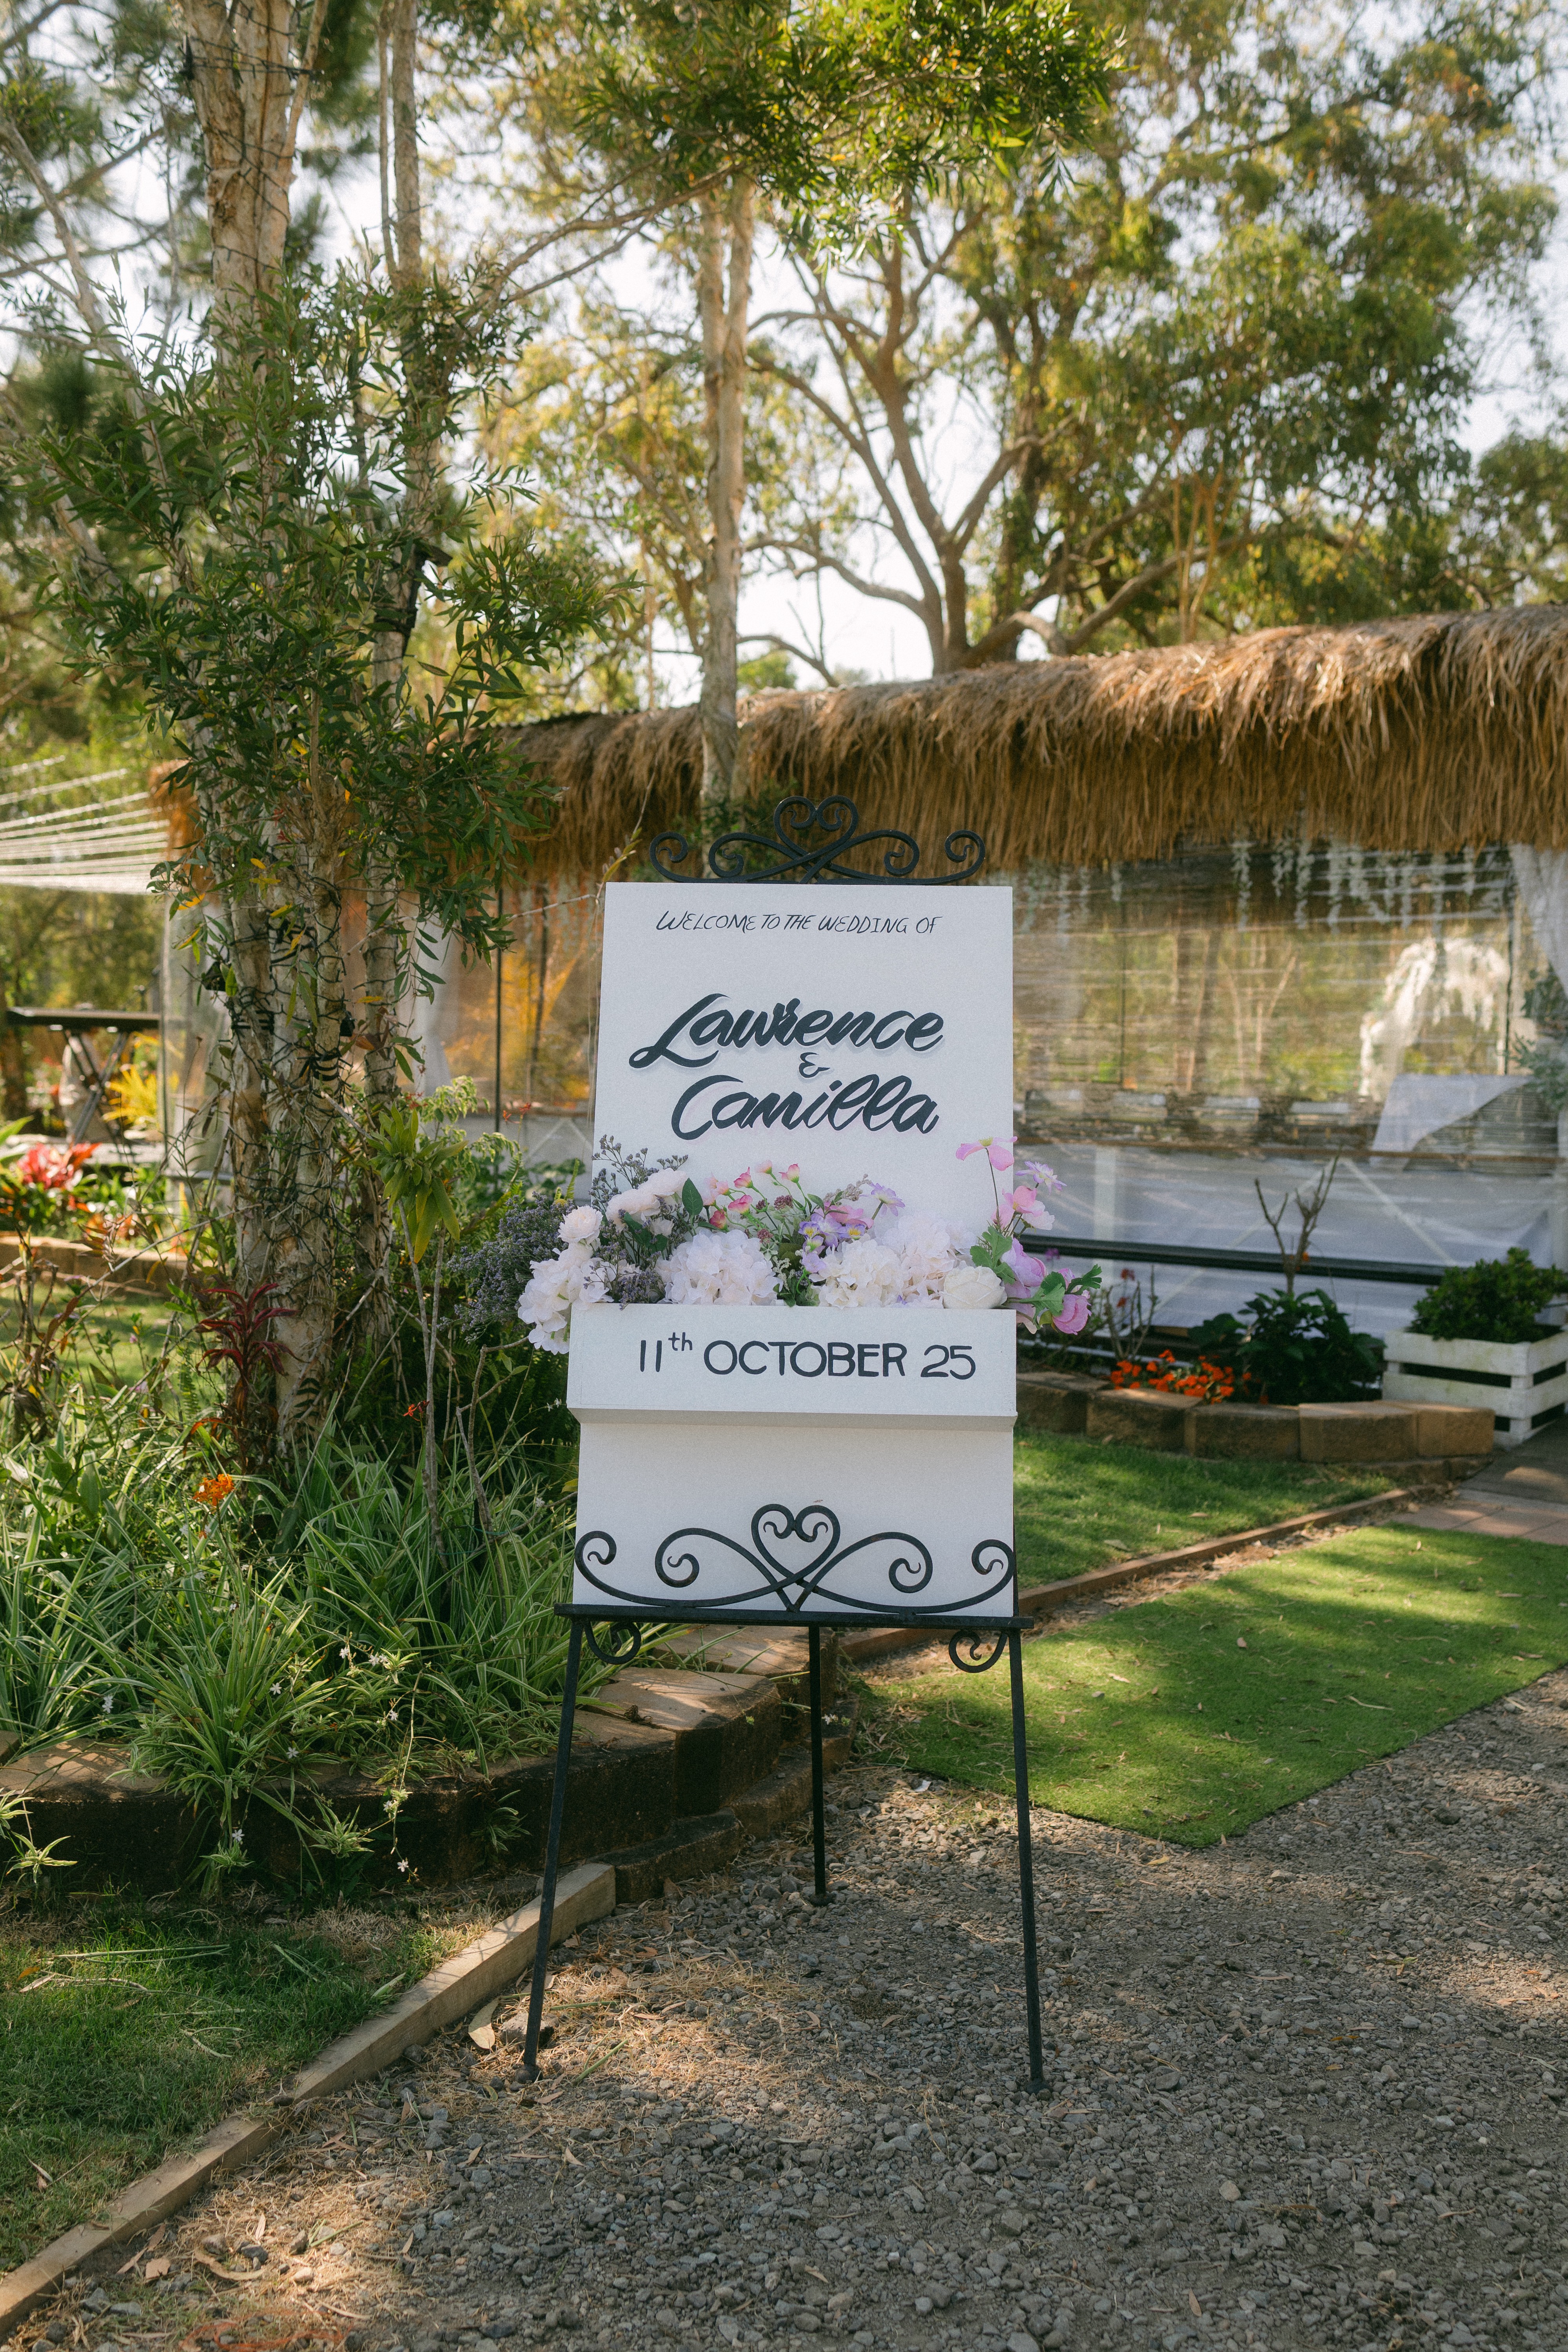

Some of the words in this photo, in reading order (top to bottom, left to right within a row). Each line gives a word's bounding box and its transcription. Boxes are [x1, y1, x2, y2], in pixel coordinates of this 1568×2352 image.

[655, 910, 757, 934] WELCOME
[761, 913, 780, 930] TO
[783, 914, 817, 930] THE
[818, 915, 909, 934] WEDDING
[916, 916, 943, 934] OF
[628, 993, 944, 1069] Lawrence
[798, 1051, 831, 1078] &
[671, 1073, 940, 1141] Camilla
[639, 1331, 693, 1373] 11th
[703, 1339, 907, 1378] OCTOBER
[920, 1344, 976, 1380] 25
